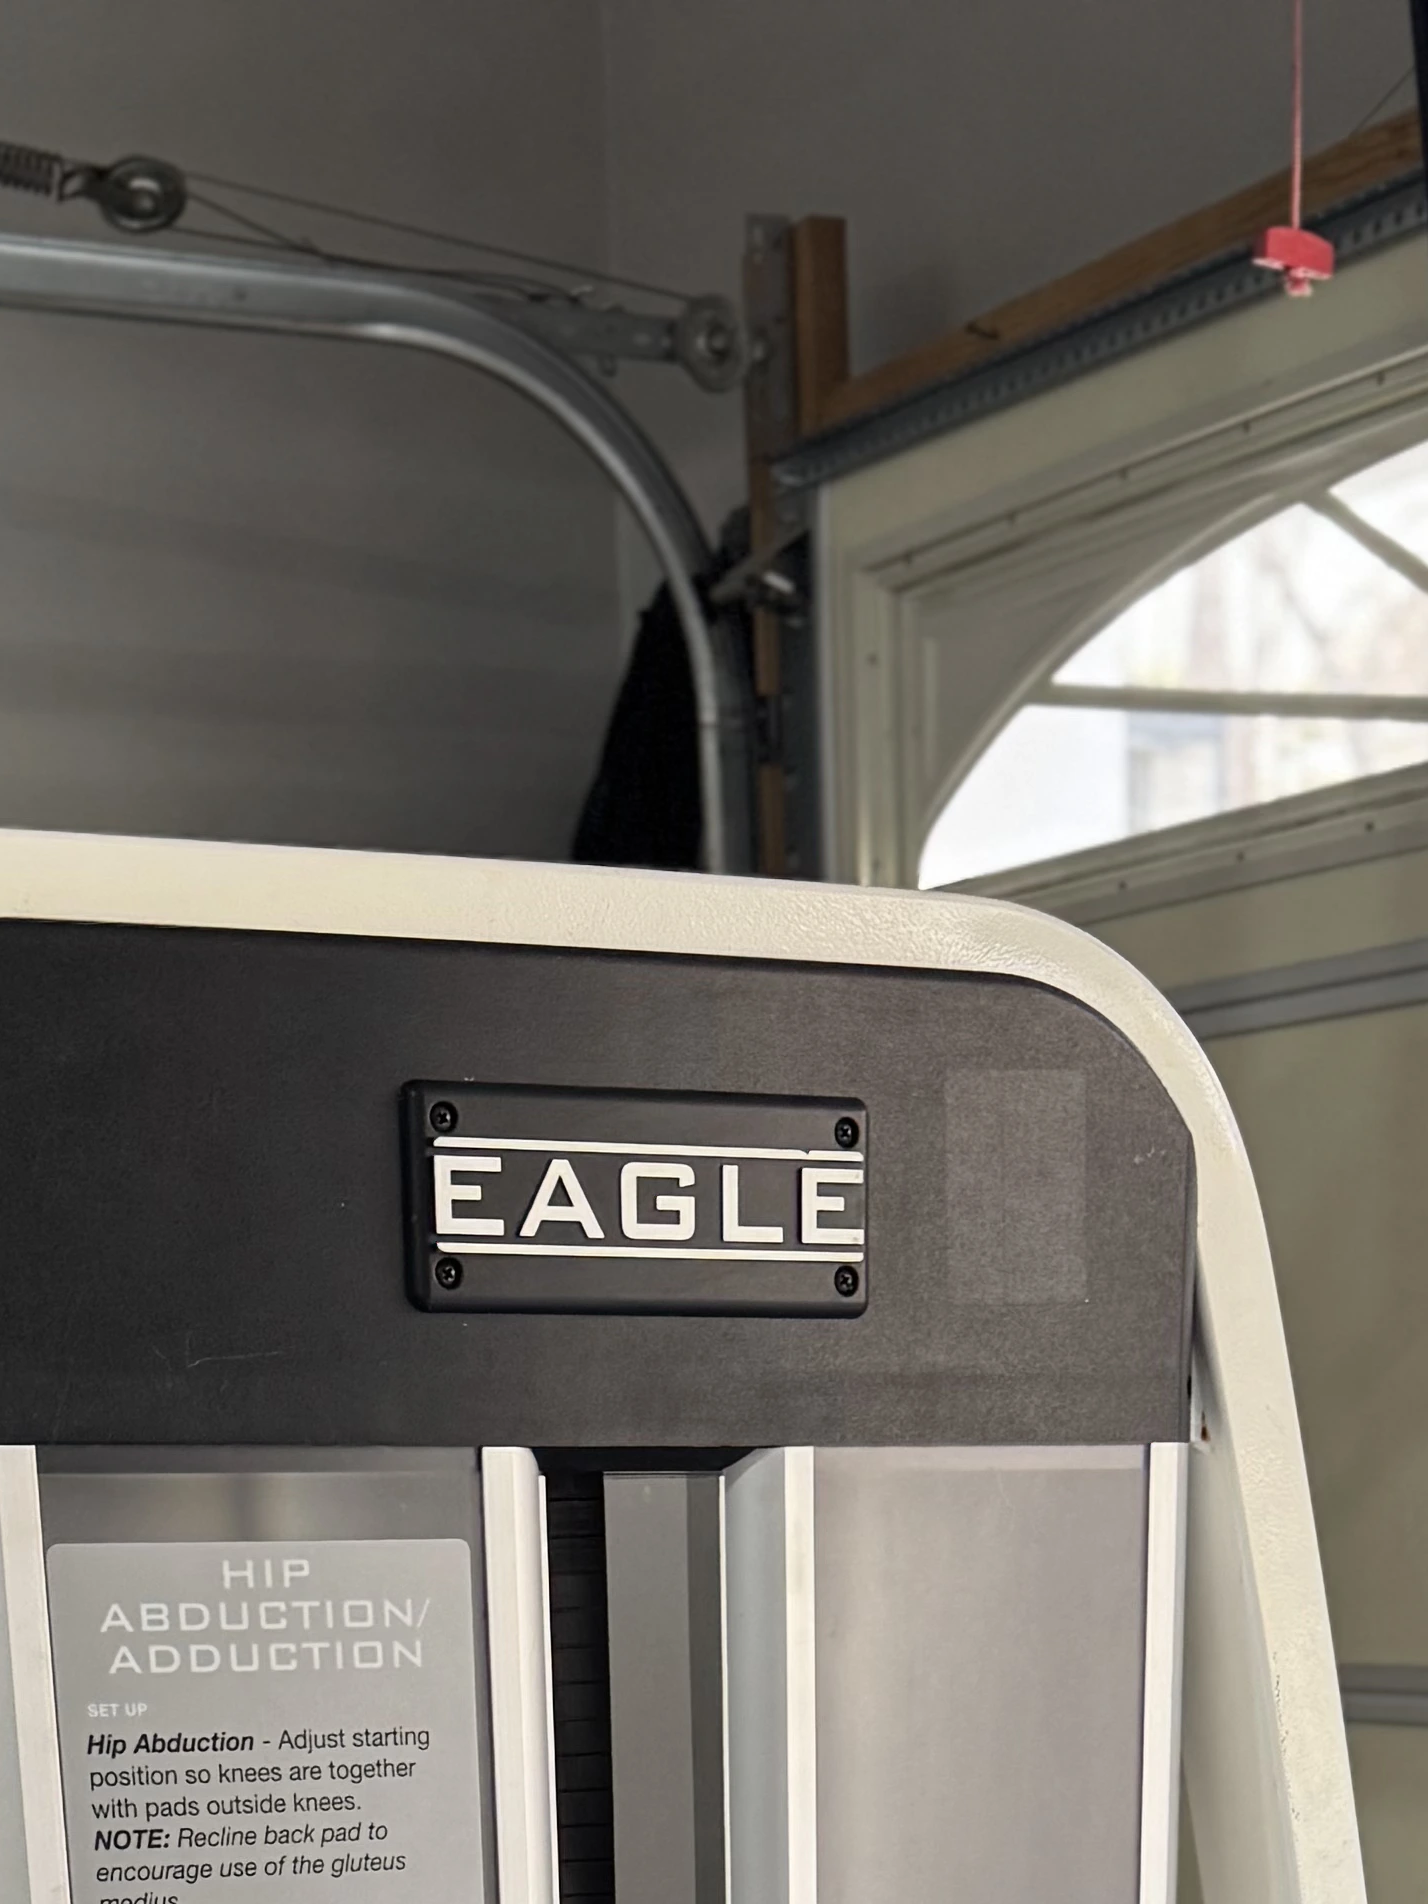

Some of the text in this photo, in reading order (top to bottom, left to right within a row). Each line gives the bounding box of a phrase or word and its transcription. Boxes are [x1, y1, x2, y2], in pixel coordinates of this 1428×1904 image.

[433, 1155, 864, 1245] EAGLE
[222, 1559, 311, 1589] HIP
[100, 1599, 430, 1632] ABDUCTION/
[109, 1640, 423, 1674] ADDUCTION
[87, 1702, 147, 1717] SET UP
[86, 1734, 127, 1757] Hip
[133, 1733, 254, 1754] Abduction
[278, 1729, 346, 1754] Adjust
[352, 1728, 430, 1750] starting
[90, 1760, 416, 1791] position so knees are together
[91, 1792, 361, 1822] with pads outside knees.
[94, 1823, 388, 1851] NOTE: Recline back pad to
[95, 1852, 406, 1887] encourage use of the gluteus
